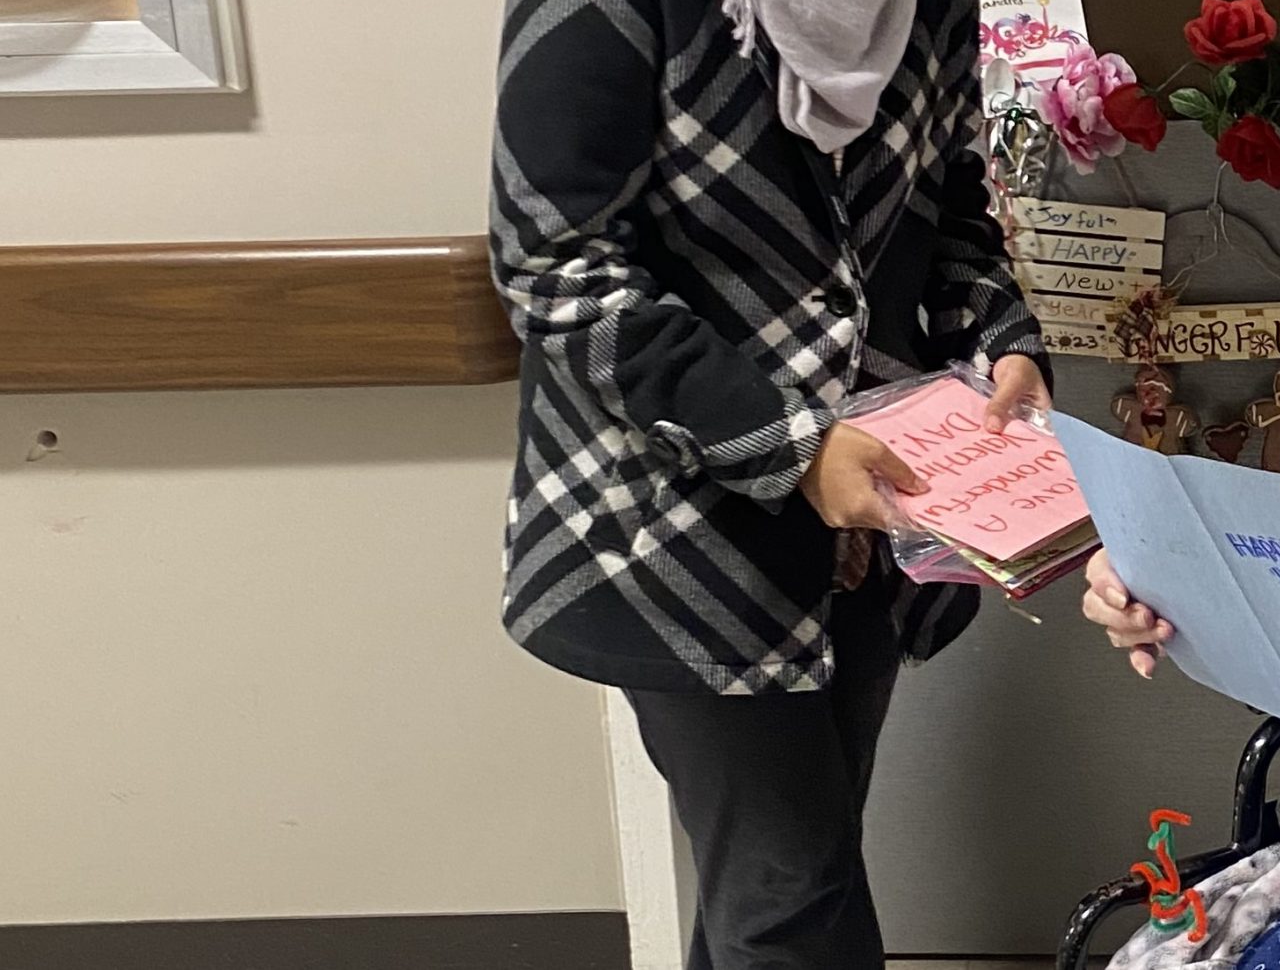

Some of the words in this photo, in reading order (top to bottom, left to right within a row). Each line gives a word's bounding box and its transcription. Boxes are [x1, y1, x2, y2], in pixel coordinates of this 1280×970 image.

[888, 412, 982, 458] DAY!
[915, 430, 1038, 482] Valentin
[1010, 477, 1077, 510] ave
[974, 514, 1009, 533] A
